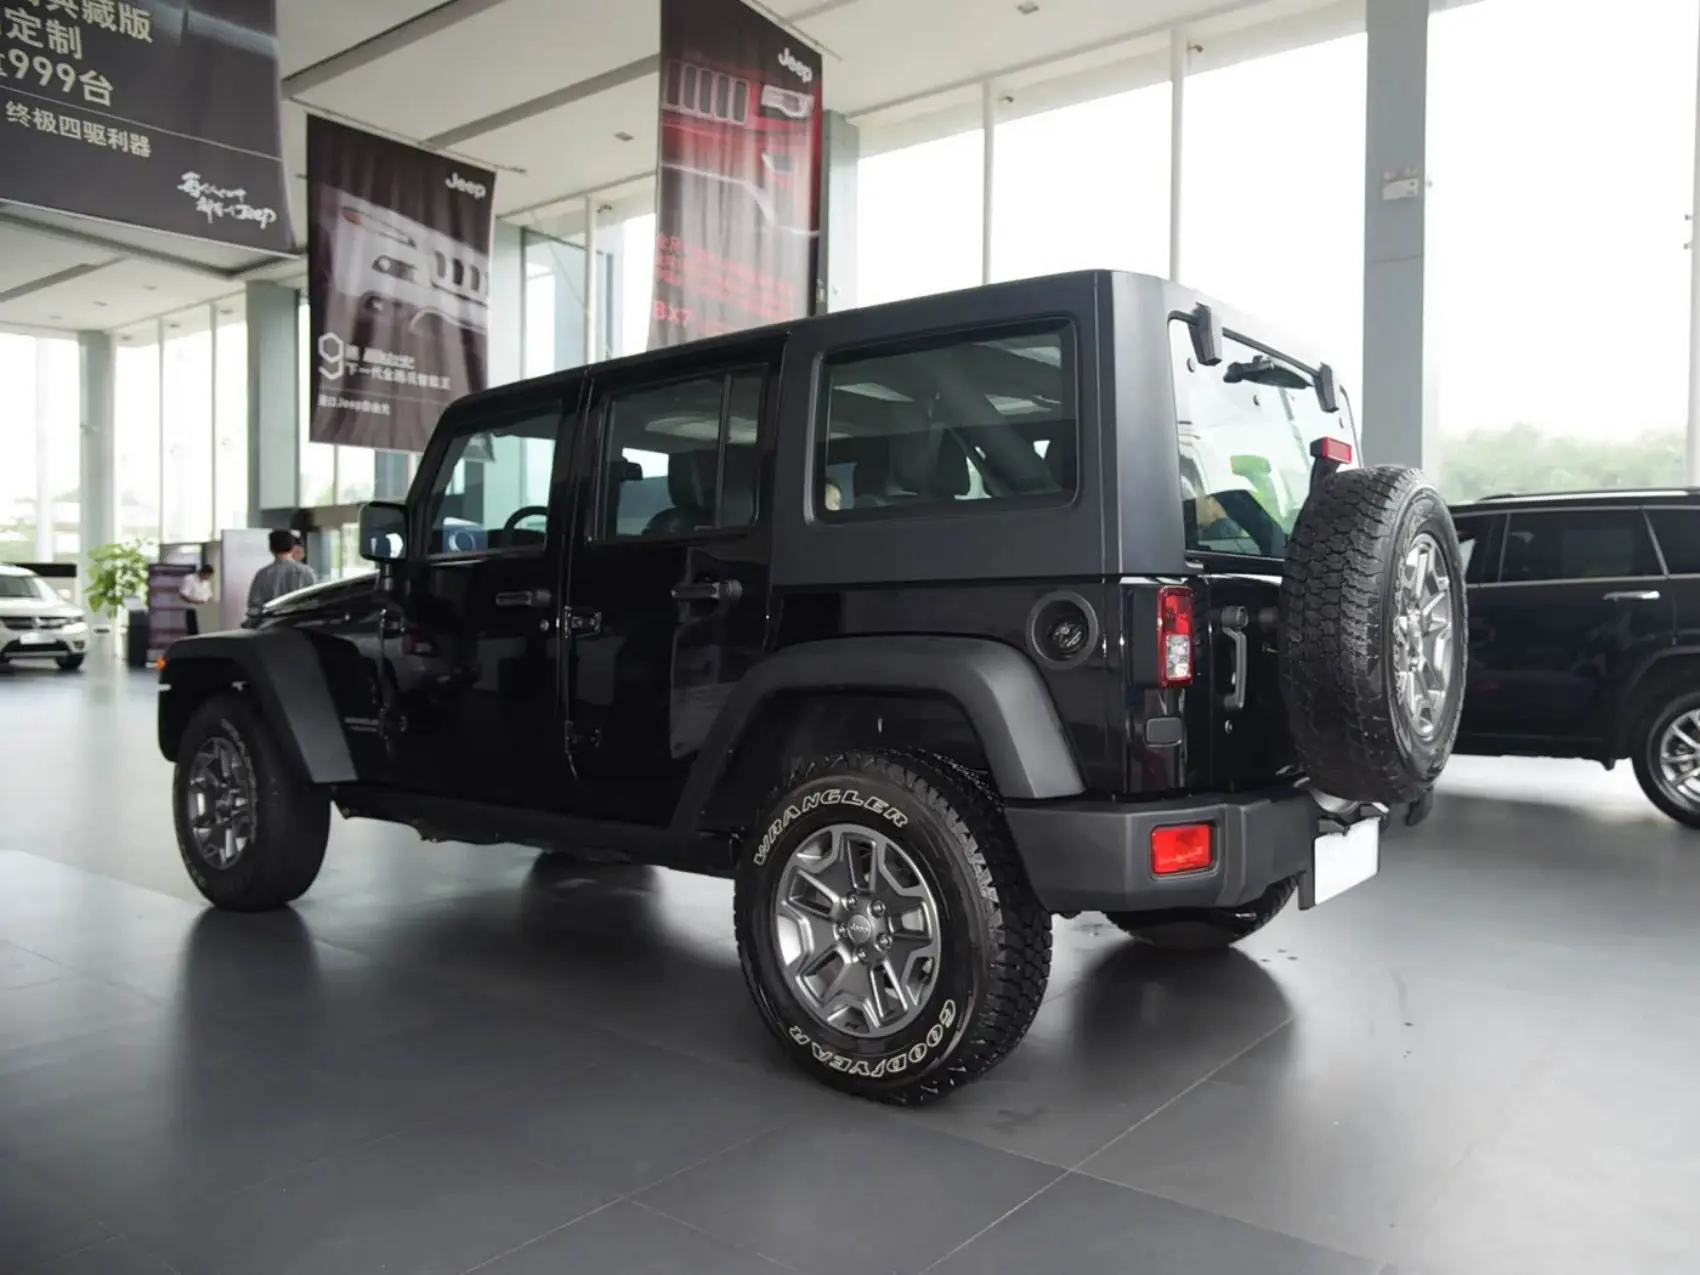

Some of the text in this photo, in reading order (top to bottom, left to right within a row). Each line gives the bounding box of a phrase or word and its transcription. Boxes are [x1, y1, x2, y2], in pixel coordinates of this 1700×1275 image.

[4, 7, 82, 59] 定制
[25, 0, 153, 43] 藏版
[0, 48, 114, 107] 999台
[778, 48, 813, 84] Jeep
[6, 100, 152, 158] 终极四驱利器
[445, 172, 487, 199] Jeep
[754, 789, 908, 866] WRANGLER
[789, 999, 956, 1078] GOODYEAR
